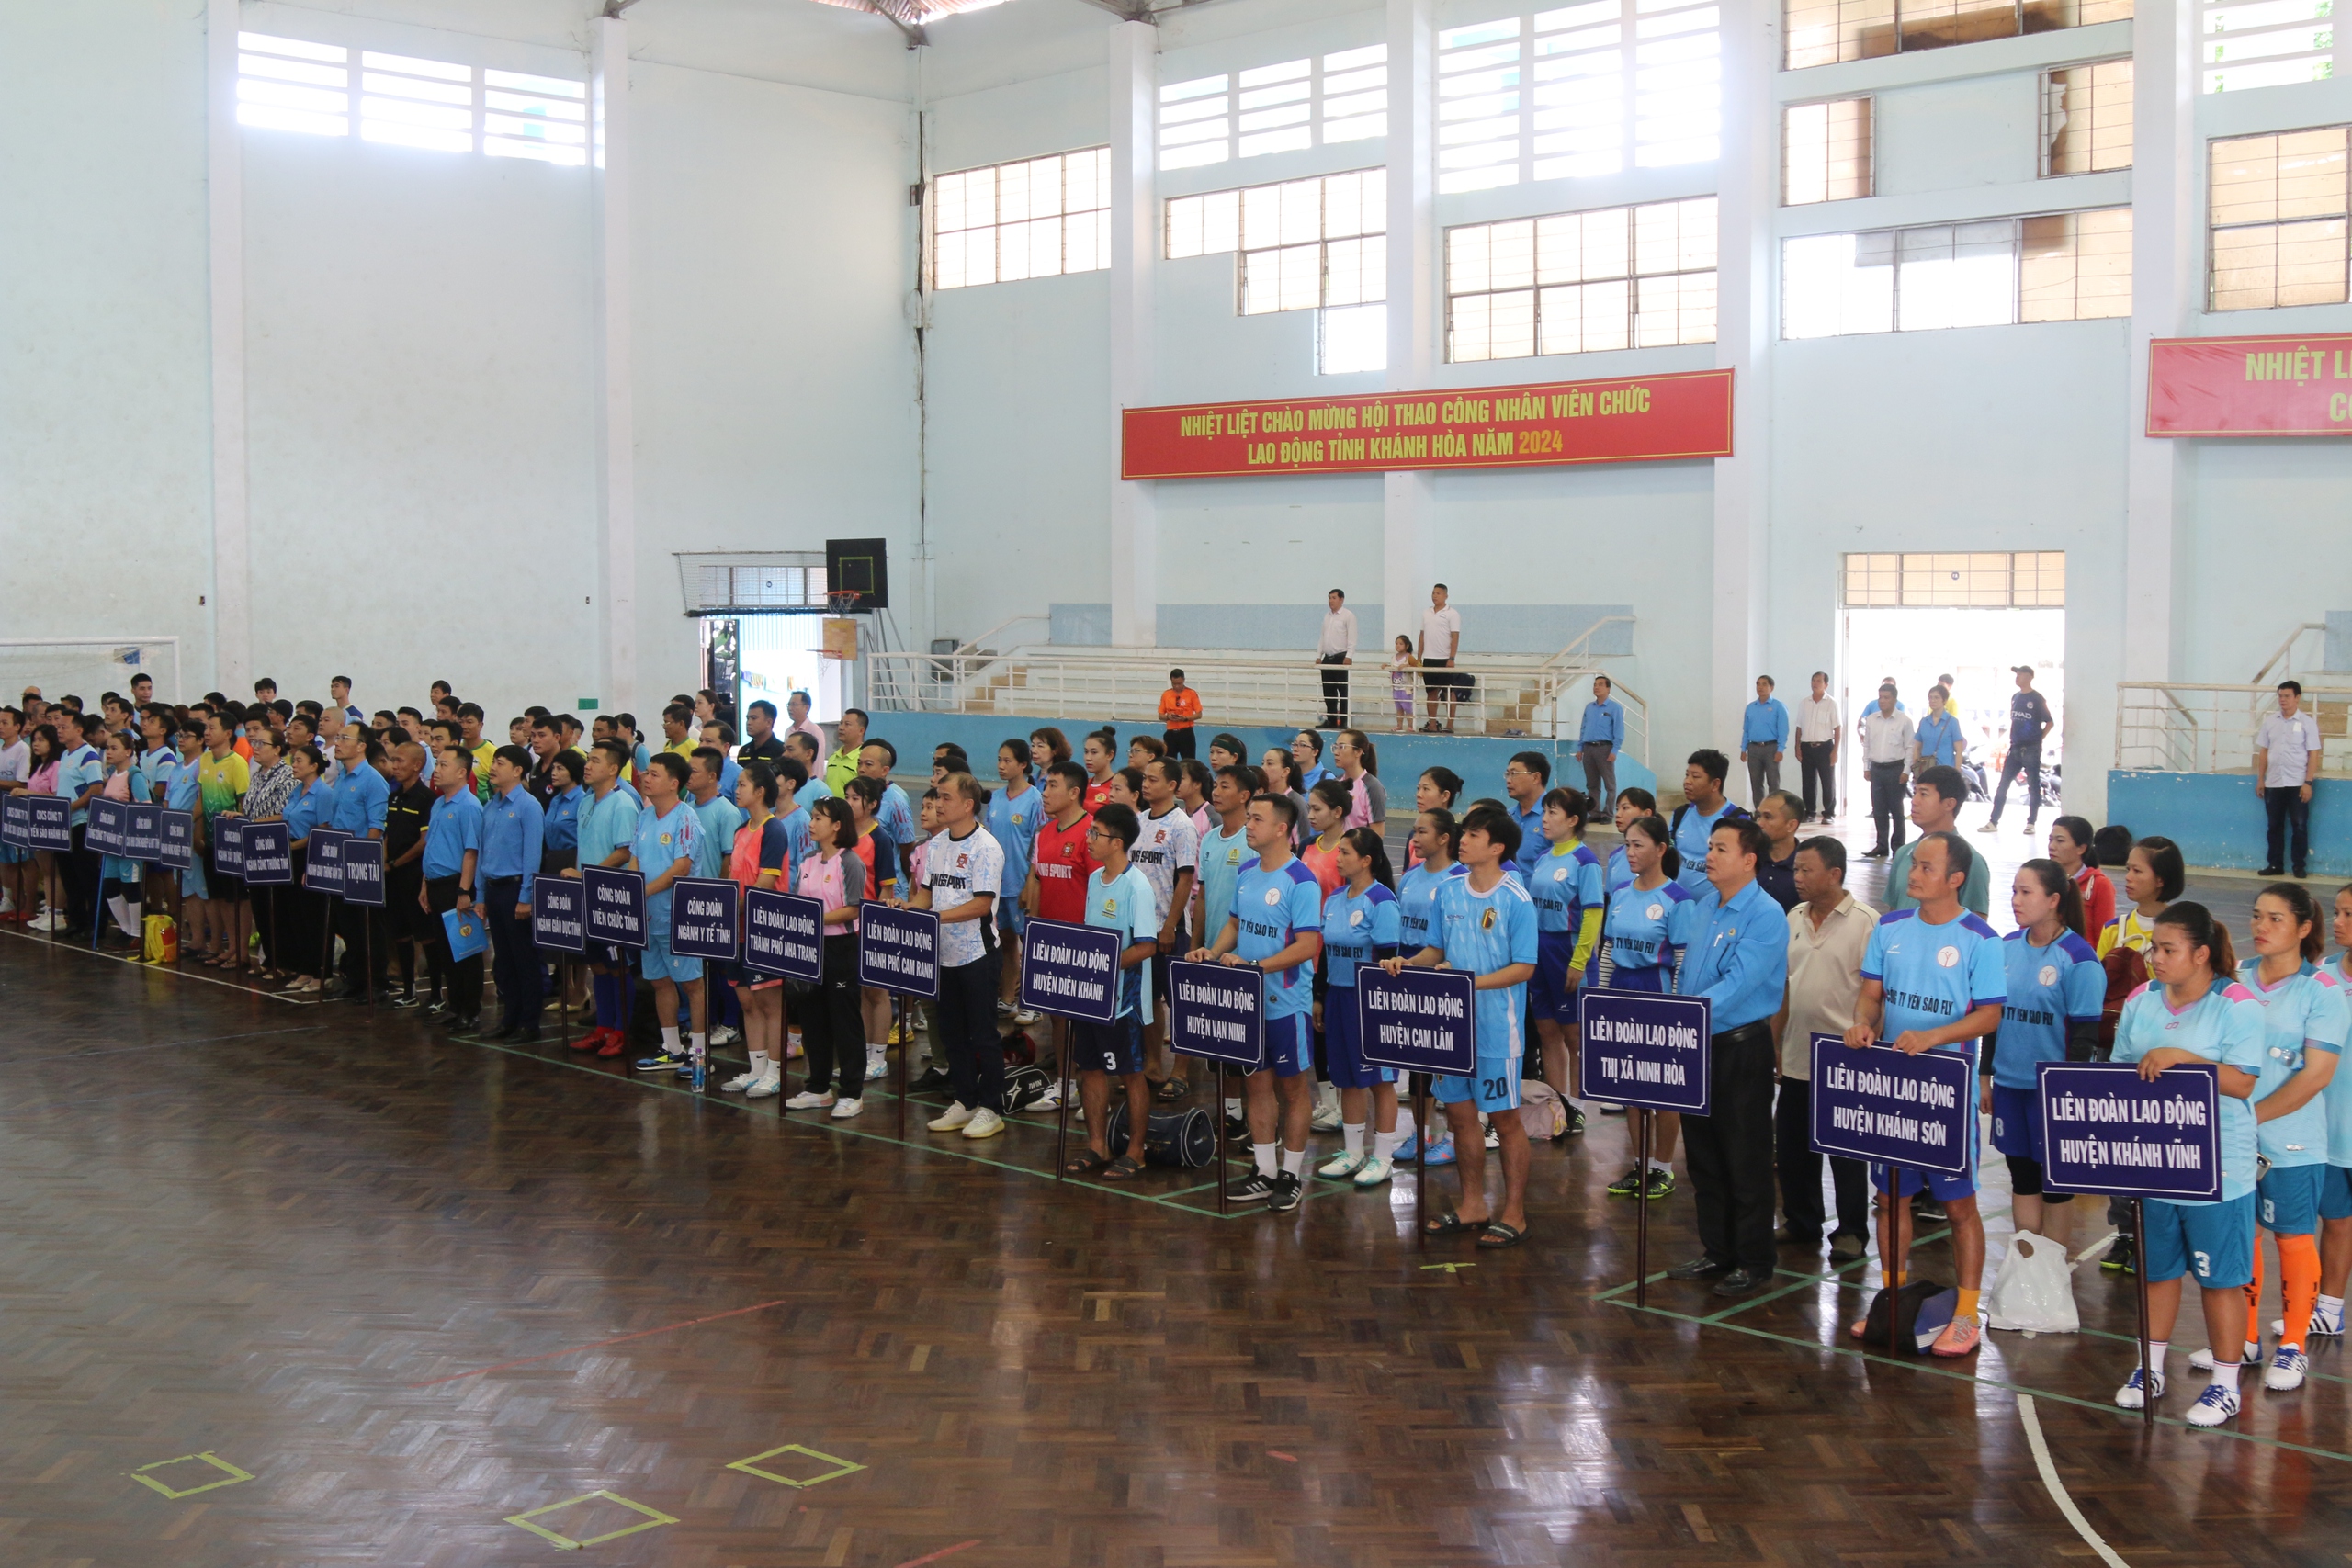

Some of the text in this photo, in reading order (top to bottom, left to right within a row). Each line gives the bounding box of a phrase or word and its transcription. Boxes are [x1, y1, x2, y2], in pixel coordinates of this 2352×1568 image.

[2245, 345, 2352, 386] NHIỆT L
[1181, 385, 1650, 440] NHIỆT LIỆT CHÀO MỪNG HỘI THAO CÔNG NHÂN VIÊN CHỨC
[1248, 428, 1562, 467] LAO ĐỘNG TỈNH KHÁNH HÒA NĂM 2024
[347, 859, 379, 883] TRỌNG TÀI
[1050, 864, 1072, 879] SPORT
[1140, 851, 1164, 865] SPORT
[547, 892, 571, 911] CÔNG ĐOÀN
[598, 883, 631, 905] CÔNG ĐOÀN
[688, 897, 723, 917] CÔNG ĐOÀN
[537, 915, 581, 937] NGÀNH GIÁO DỤC TỈNH
[592, 908, 638, 931] VIÊN CHỨC TỈNH
[678, 922, 731, 944] NGÀNH Y TẾ TỈNH
[754, 906, 814, 937] LIÊN ĐOÀN LAO ĐỘNG
[1254, 922, 1267, 936] SÀO
[1268, 926, 1278, 938] FLY
[750, 932, 817, 963] THÀNH PHỐ NHA TRANG
[867, 920, 932, 952] LIÊN ĐOÀN LAO ĐỘNG
[865, 948, 933, 979] THÀNH PHỐ CAM RANH
[1032, 939, 1109, 973] LIÊN ĐOÀN LAO ĐỘNG
[1353, 947, 1363, 958] FLY
[1033, 971, 1104, 1002] HUYỆN DIÊN KHÁNH
[1179, 979, 1254, 1013] LIÊN ĐOÀN LAO ĐỘNG
[1368, 986, 1463, 1021] LIÊN ĐOÀN LAO ĐỘNG
[1899, 992, 1906, 1007] TY
[1908, 990, 1921, 1010] YẾN
[1922, 995, 1939, 1013] SÀO
[1941, 1000, 1953, 1015] FLY
[2007, 1006, 2016, 1020] TY
[2043, 1012, 2054, 1026] FLY
[1187, 1013, 1246, 1042] HUYỆN VẠN NINH
[1380, 1021, 1454, 1051] HUYỆN CAM LÂM
[1590, 1015, 1697, 1052] LIÊN ĐOÀN LAO ĐỘNG
[1104, 1052, 1117, 1070] 3
[1601, 1054, 1686, 1086] THỊ XÃ NINH HÒA
[1483, 1076, 1507, 1101] 20
[1827, 1062, 1955, 1109] LIÊN ĐOÀN LAO ĐỘNG
[2052, 1091, 2206, 1130] LIÊN ĐOÀN LAO ĐỘNG
[1833, 1104, 1946, 1147] HUYỆN KHÁNH SƠN
[1996, 1117, 2004, 1137] 8
[2060, 1134, 2201, 1170] HUYỆN KHÁNH VĨNH
[2263, 1198, 2275, 1223] 8
[2194, 1251, 2210, 1277] 3
